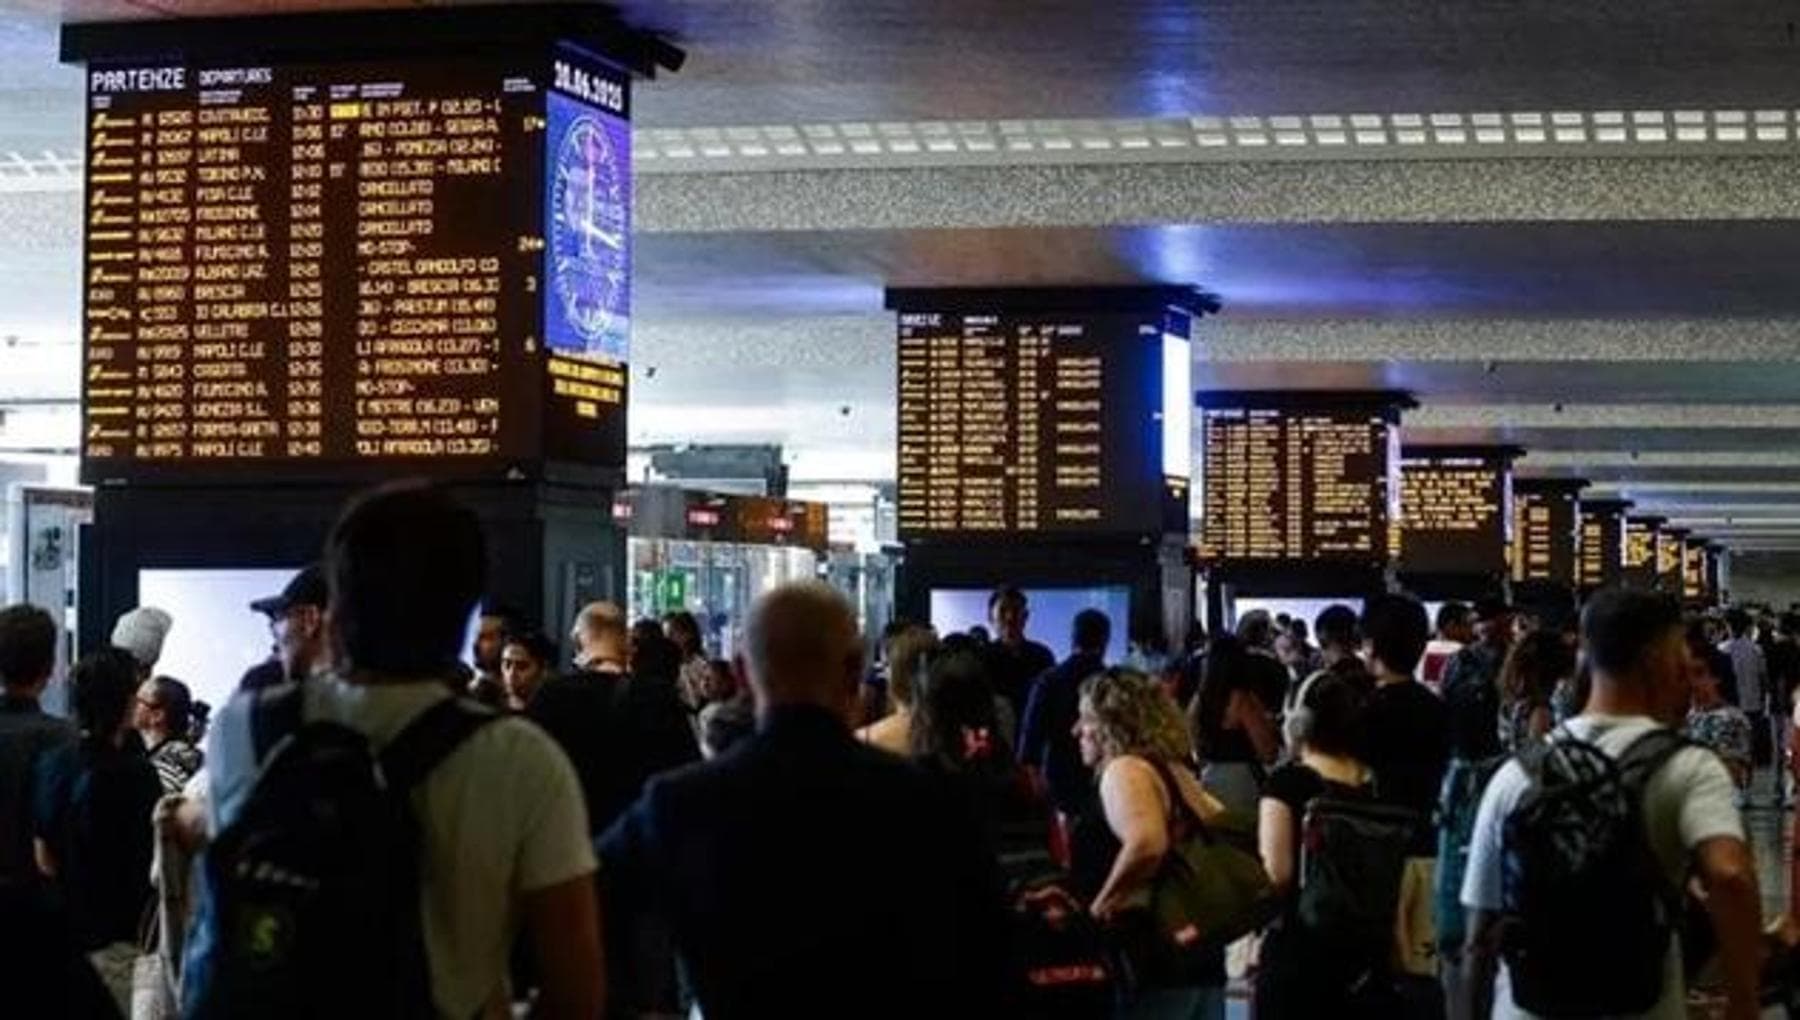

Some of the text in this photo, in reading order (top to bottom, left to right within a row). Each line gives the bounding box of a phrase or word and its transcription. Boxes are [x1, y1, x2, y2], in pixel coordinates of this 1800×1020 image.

[91, 69, 184, 92] PARTENZE
[200, 69, 271, 85] DEPARTURES
[358, 181, 433, 195] CANCELLATO
[358, 201, 433, 214] CANCELLATO
[358, 221, 433, 234] CANCELLATO
